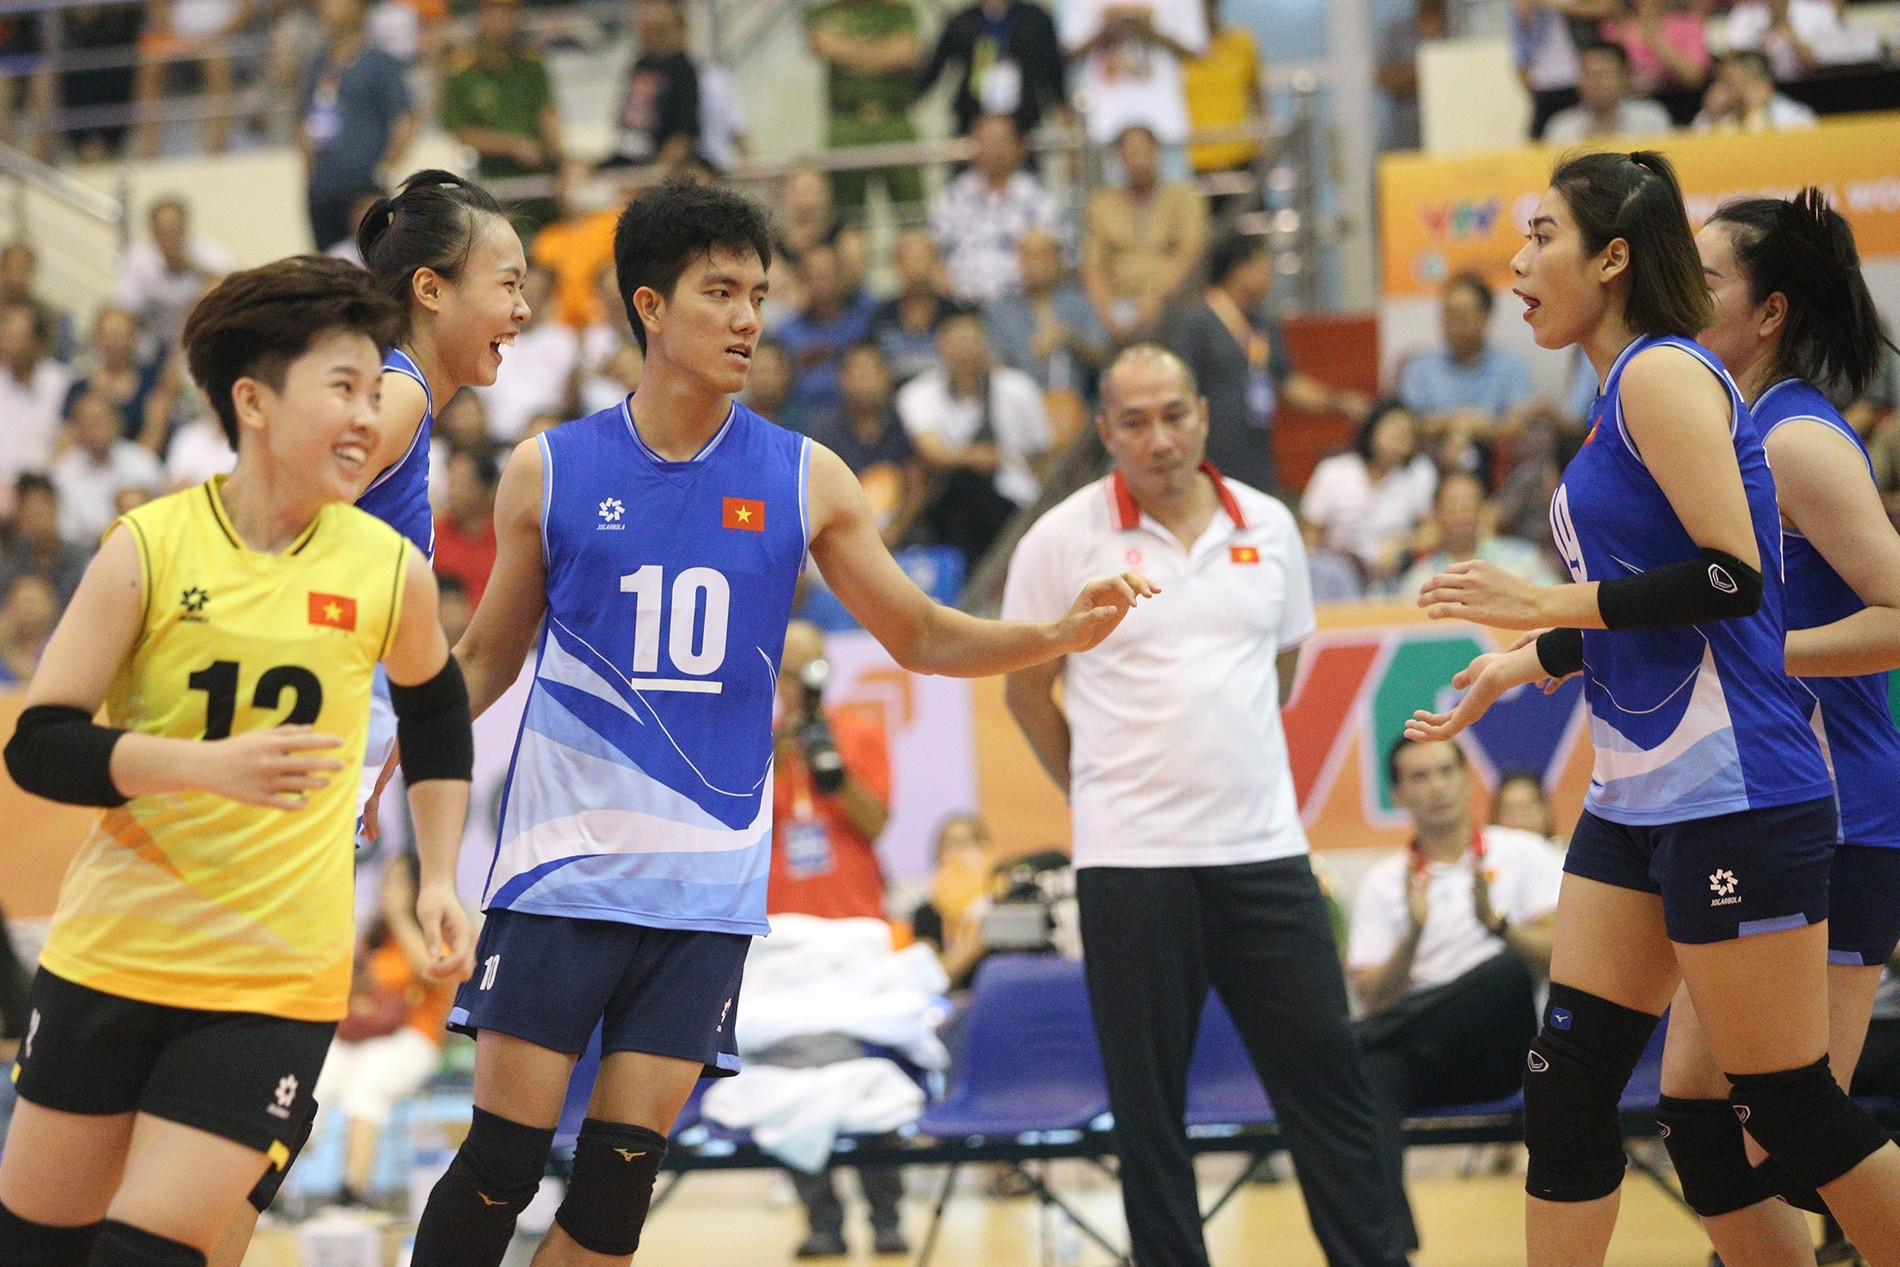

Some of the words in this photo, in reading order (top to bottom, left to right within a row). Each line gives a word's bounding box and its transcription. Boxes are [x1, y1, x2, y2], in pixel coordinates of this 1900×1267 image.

[620, 564, 731, 676] 10
[188, 659, 323, 741] 12
[479, 954, 501, 991] 10
